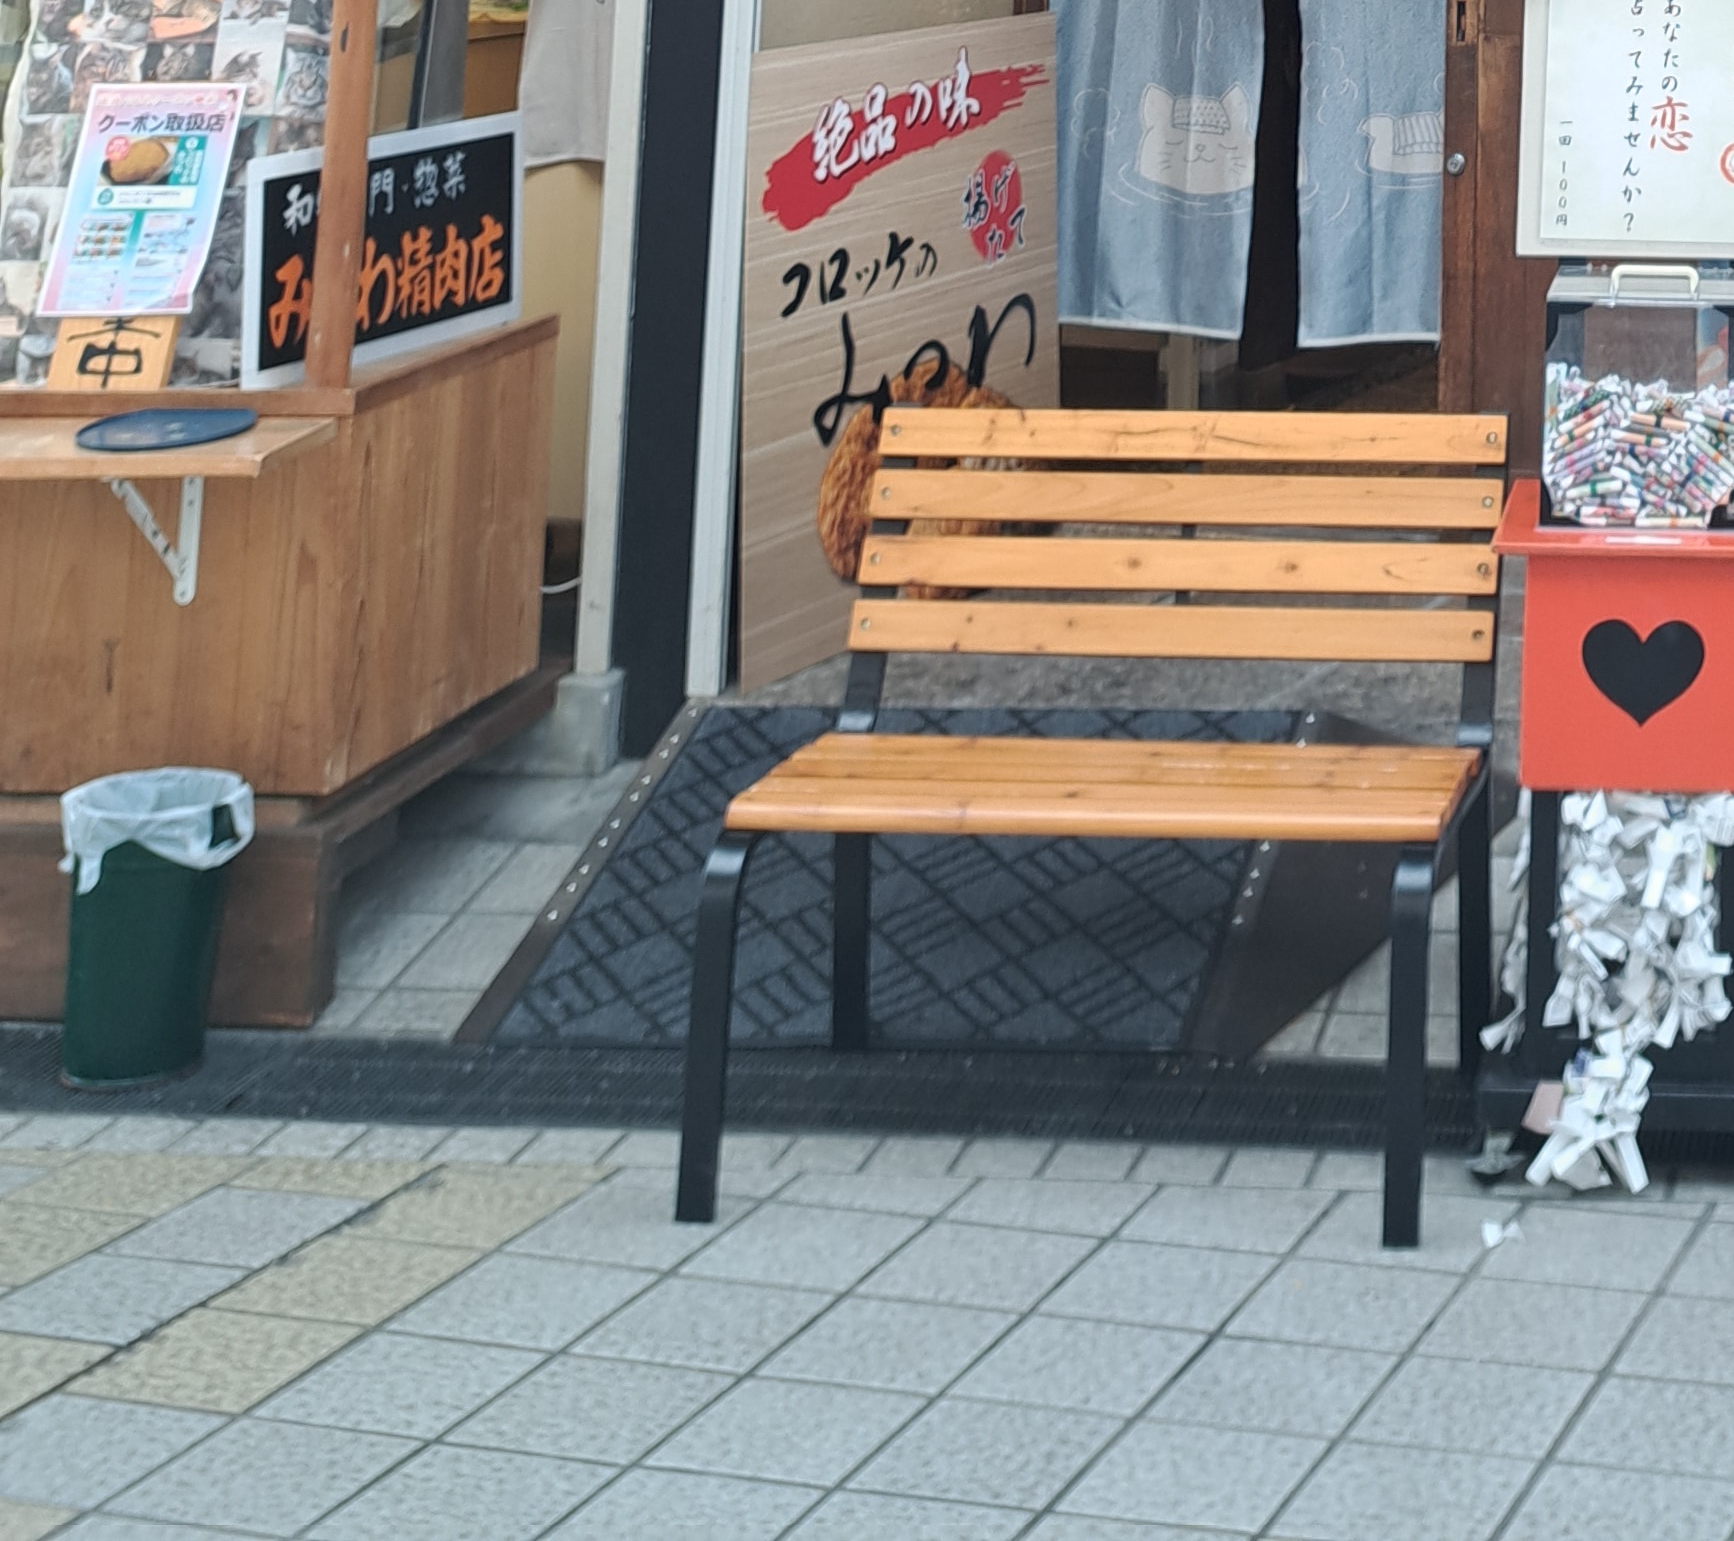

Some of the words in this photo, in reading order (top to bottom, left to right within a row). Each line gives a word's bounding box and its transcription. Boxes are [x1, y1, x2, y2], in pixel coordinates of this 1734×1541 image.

[98, 111, 225, 134] クーポン取扱店
[811, 46, 982, 183] 絶品の味
[282, 150, 466, 237] 和門・惣菜
[268, 214, 505, 349] みわ精肉店
[781, 231, 938, 319] コロッケの
